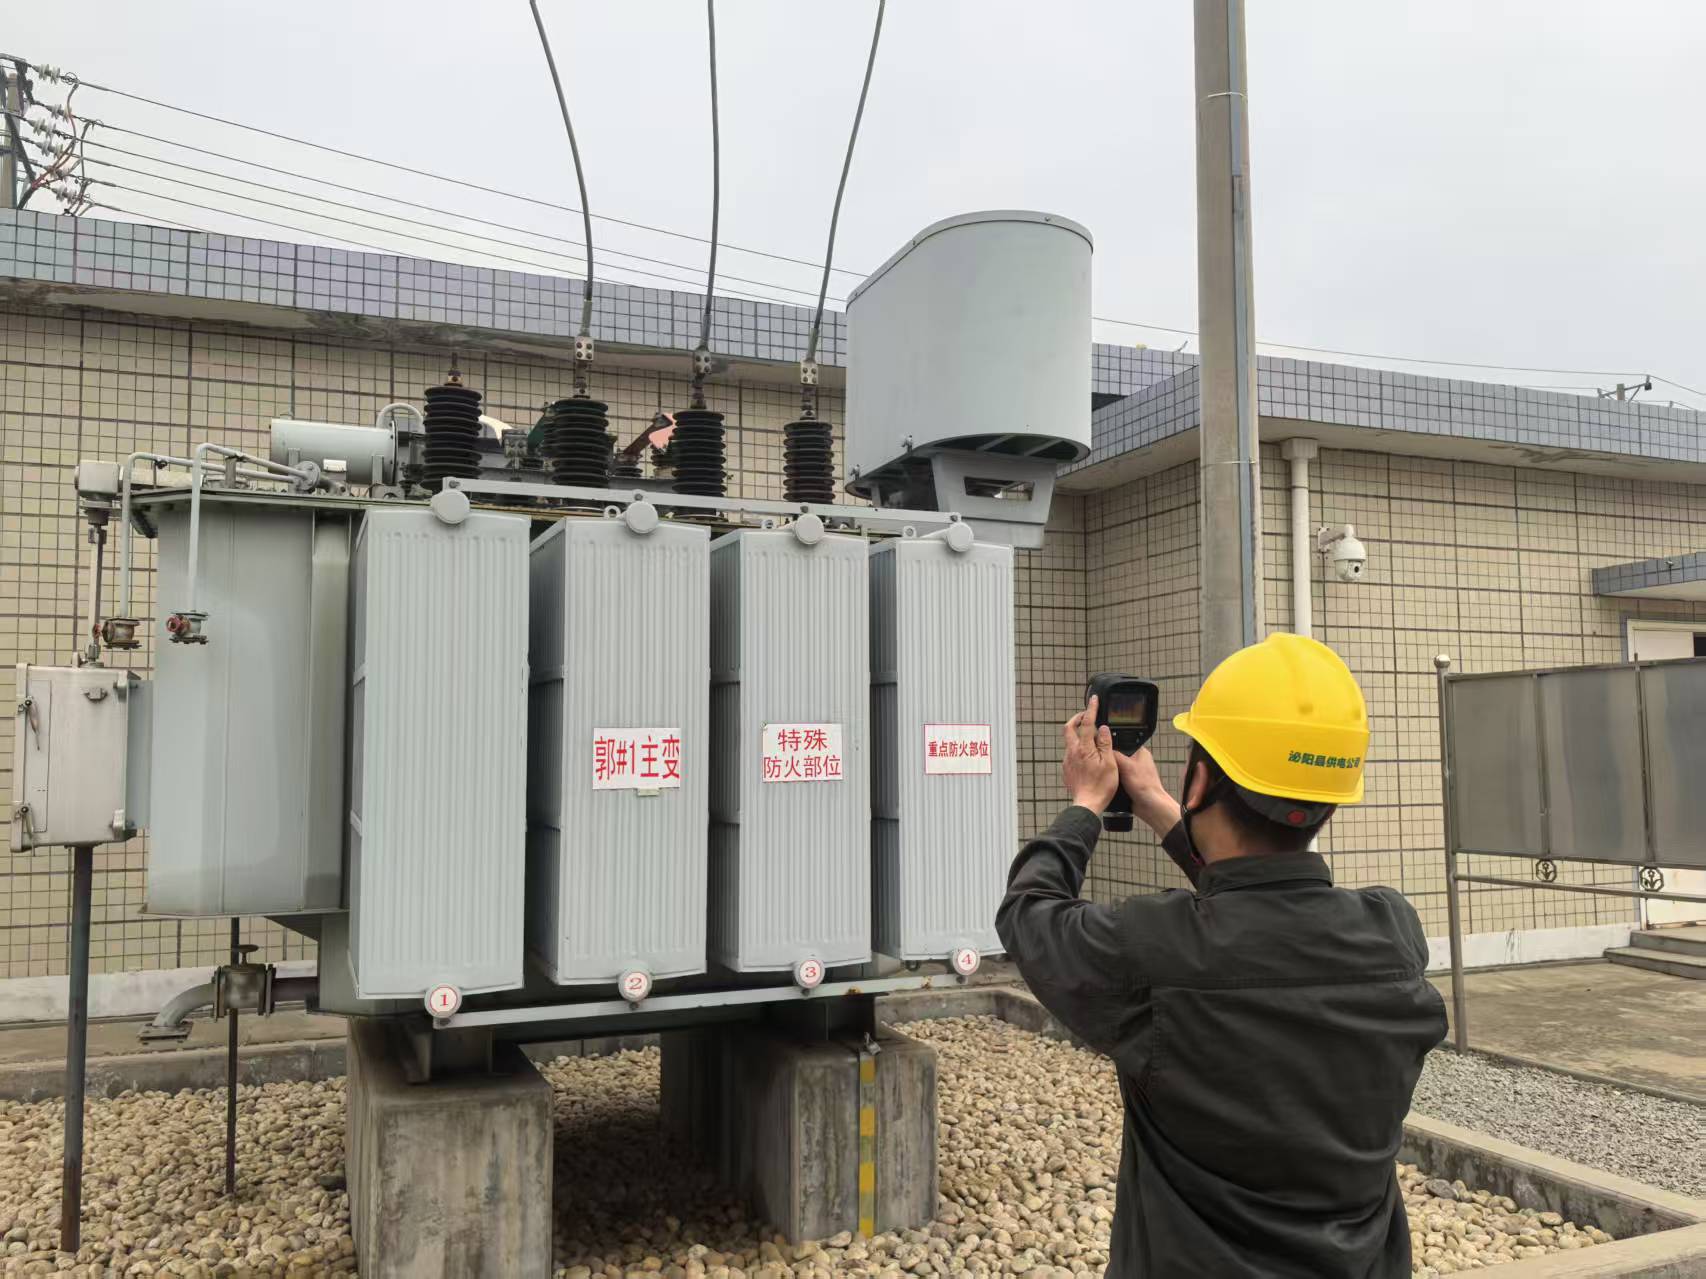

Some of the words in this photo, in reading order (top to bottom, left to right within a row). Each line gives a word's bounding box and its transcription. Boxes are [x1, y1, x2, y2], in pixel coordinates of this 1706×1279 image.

[778, 729, 828, 752] 特殊
[928, 740, 989, 758] 重点防火部位
[595, 734, 680, 780] 郭#1主变
[763, 755, 841, 779] 防火部位
[961, 953, 973, 965] 4
[805, 966, 817, 978] 3
[630, 977, 642, 990] 2
